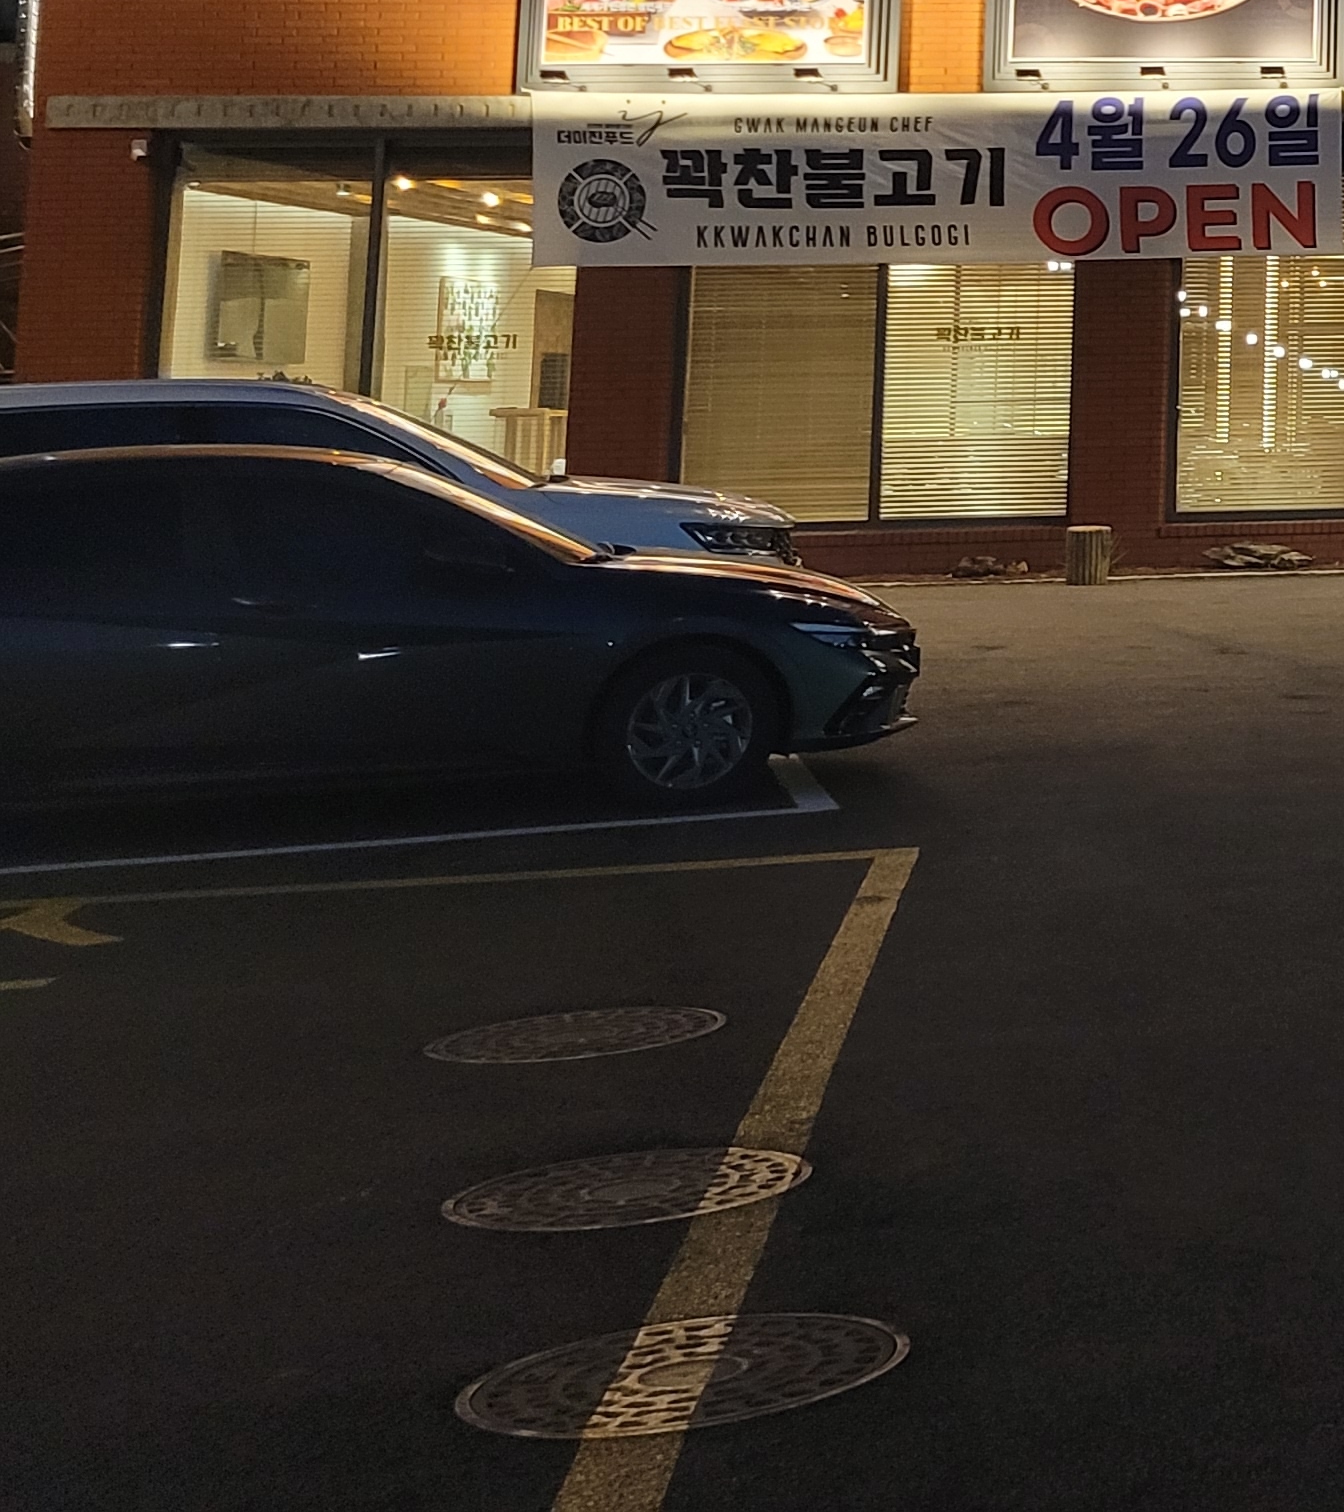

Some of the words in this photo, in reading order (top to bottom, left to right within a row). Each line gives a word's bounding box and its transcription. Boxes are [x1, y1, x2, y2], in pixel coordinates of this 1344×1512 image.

[557, 15, 608, 32] BEST
[617, 15, 650, 32] OF
[653, 15, 705, 31] BEST
[734, 116, 785, 134] GWAK
[795, 116, 879, 134] MANGEUN
[889, 116, 934, 133] CHEF
[1035, 96, 1144, 171] 4월
[1168, 93, 1320, 169] 26일
[660, 147, 1005, 210] 꽉찬불고기
[696, 225, 850, 249] KKWAKCHAN
[867, 223, 970, 248] BULGOGI
[1032, 180, 1318, 257] OPEN
